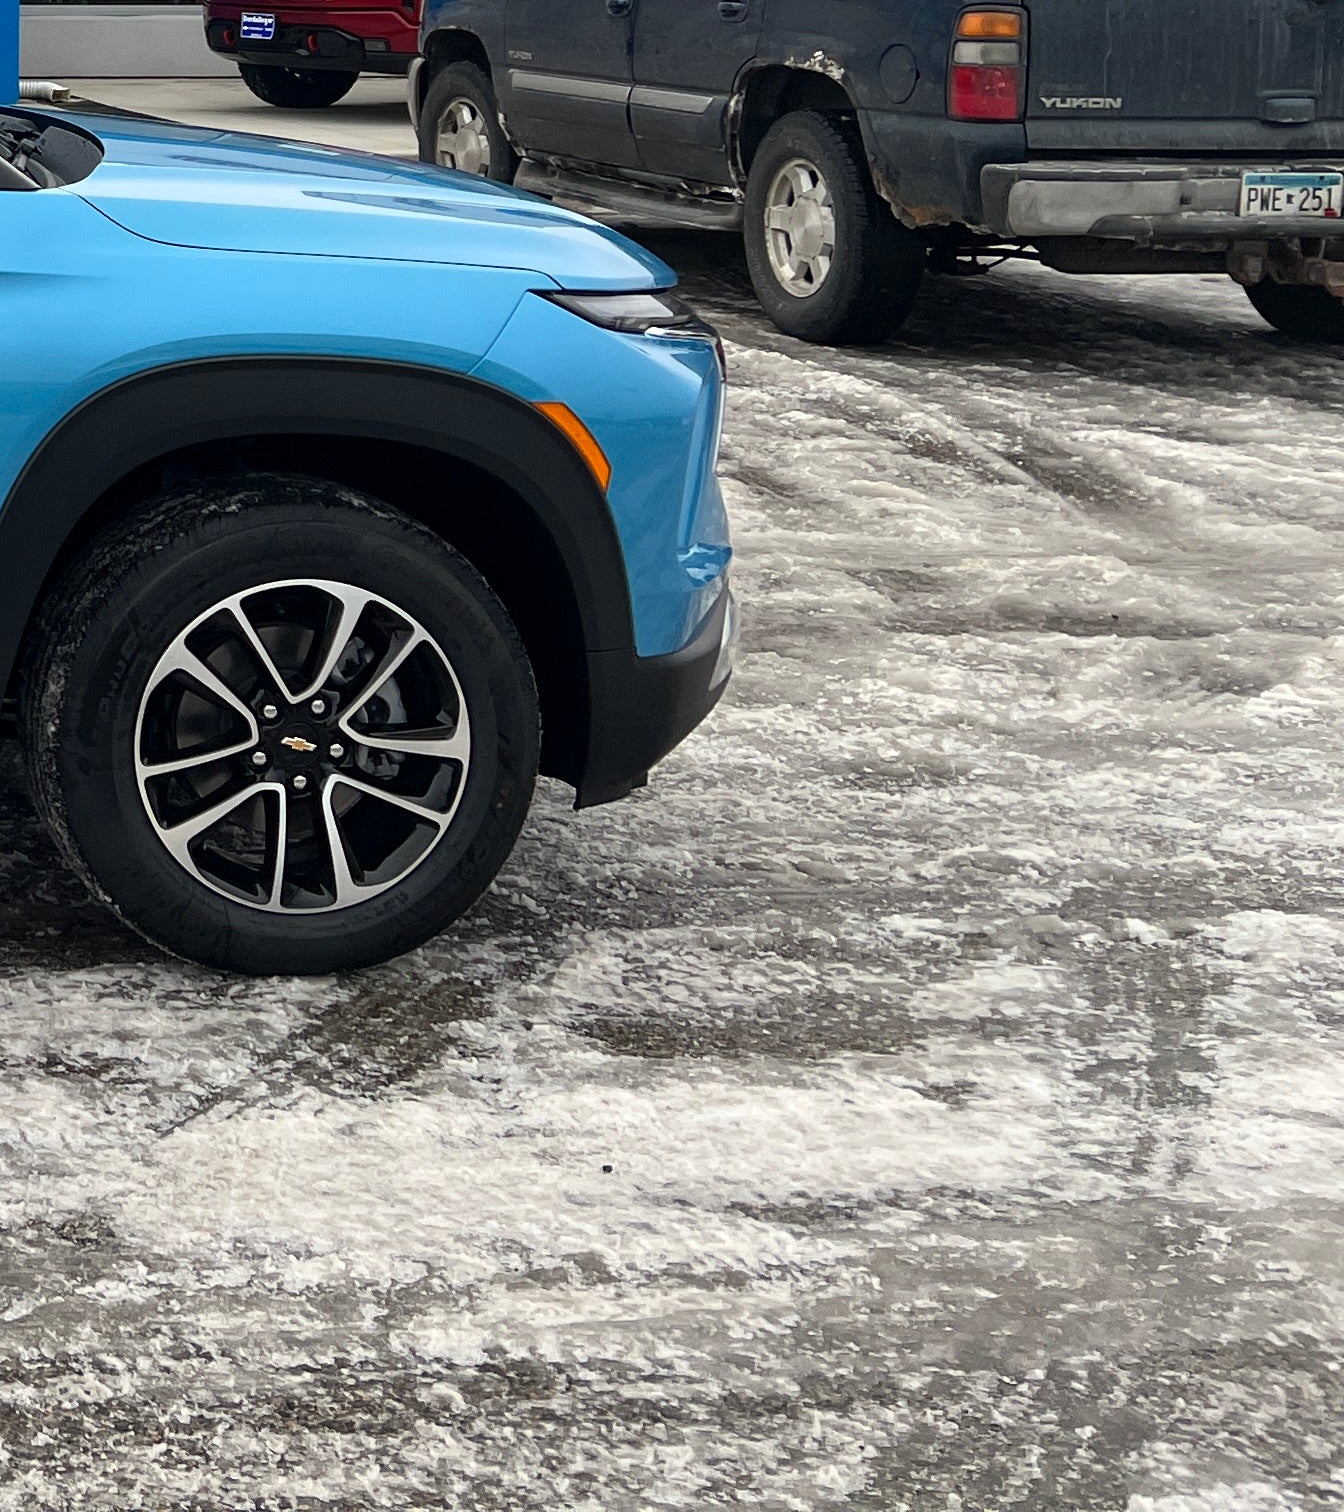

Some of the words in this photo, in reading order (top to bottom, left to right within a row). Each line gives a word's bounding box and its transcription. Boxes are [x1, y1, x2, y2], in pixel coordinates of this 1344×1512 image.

[1039, 97, 1123, 109] YUKON
[1246, 187, 1284, 212] PWE
[1298, 187, 1332, 212] 251
